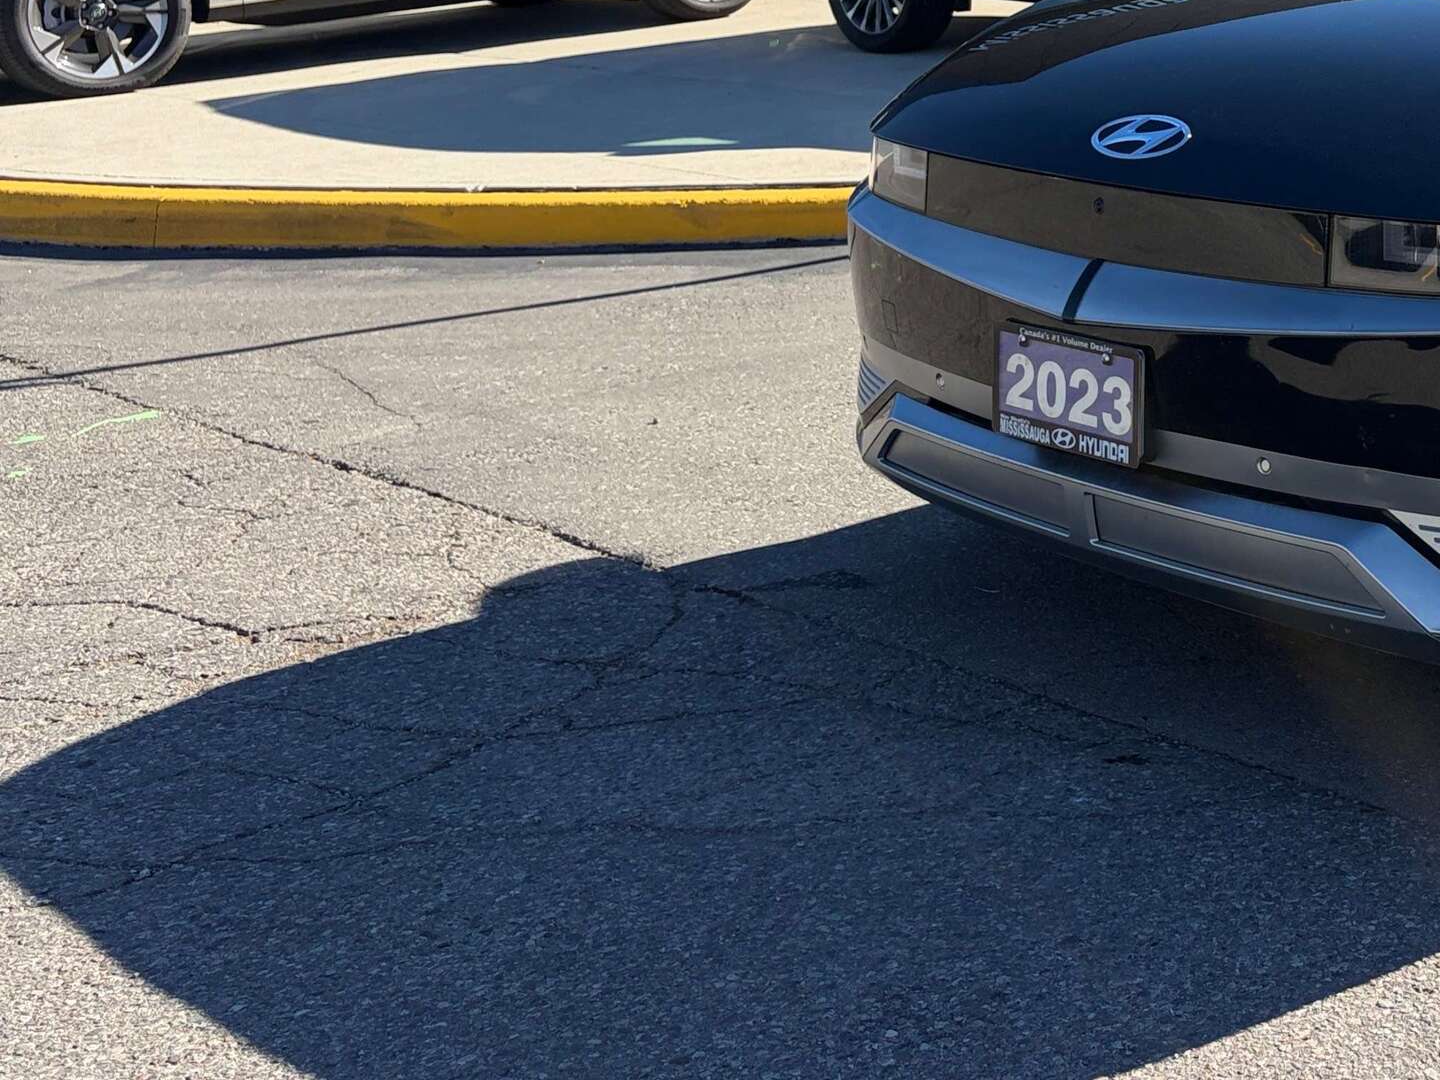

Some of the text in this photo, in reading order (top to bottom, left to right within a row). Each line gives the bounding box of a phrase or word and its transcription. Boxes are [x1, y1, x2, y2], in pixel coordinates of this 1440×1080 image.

[1019, 327, 1113, 354] Canada's #1 Volume Dealer
[1005, 353, 1133, 436] 2023
[1000, 417, 1129, 464] MISSISSAUGA HYUNDAI
